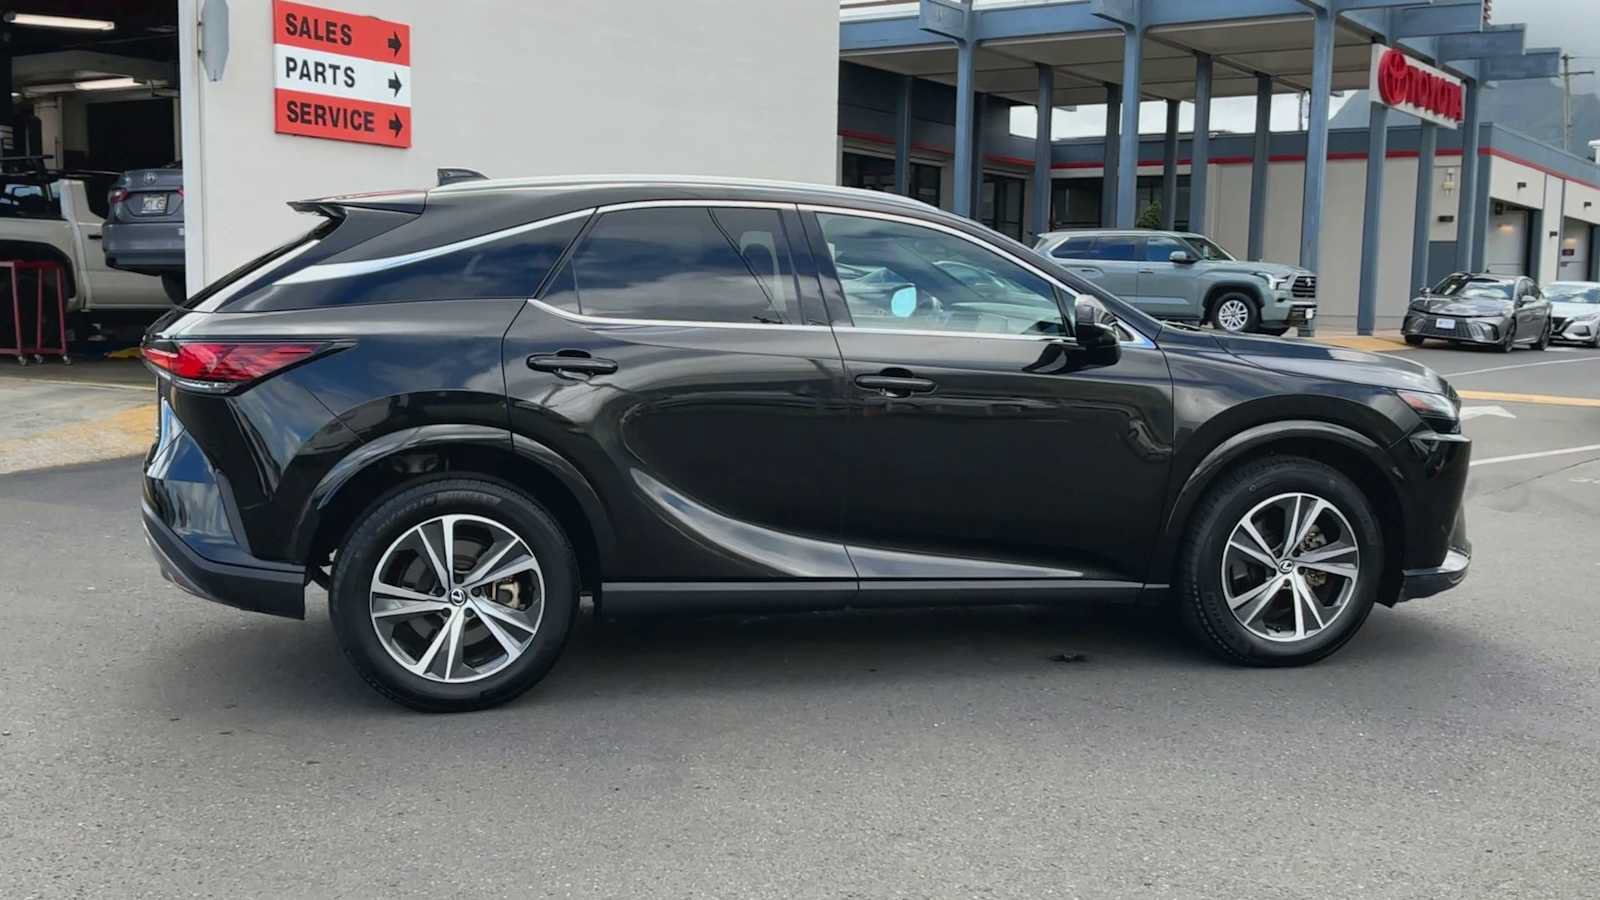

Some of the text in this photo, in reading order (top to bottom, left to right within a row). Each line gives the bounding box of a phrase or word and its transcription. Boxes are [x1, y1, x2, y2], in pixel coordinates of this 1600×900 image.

[285, 13, 352, 46] SALES
[285, 56, 355, 88] PARTS
[286, 101, 375, 132] SERVICE
